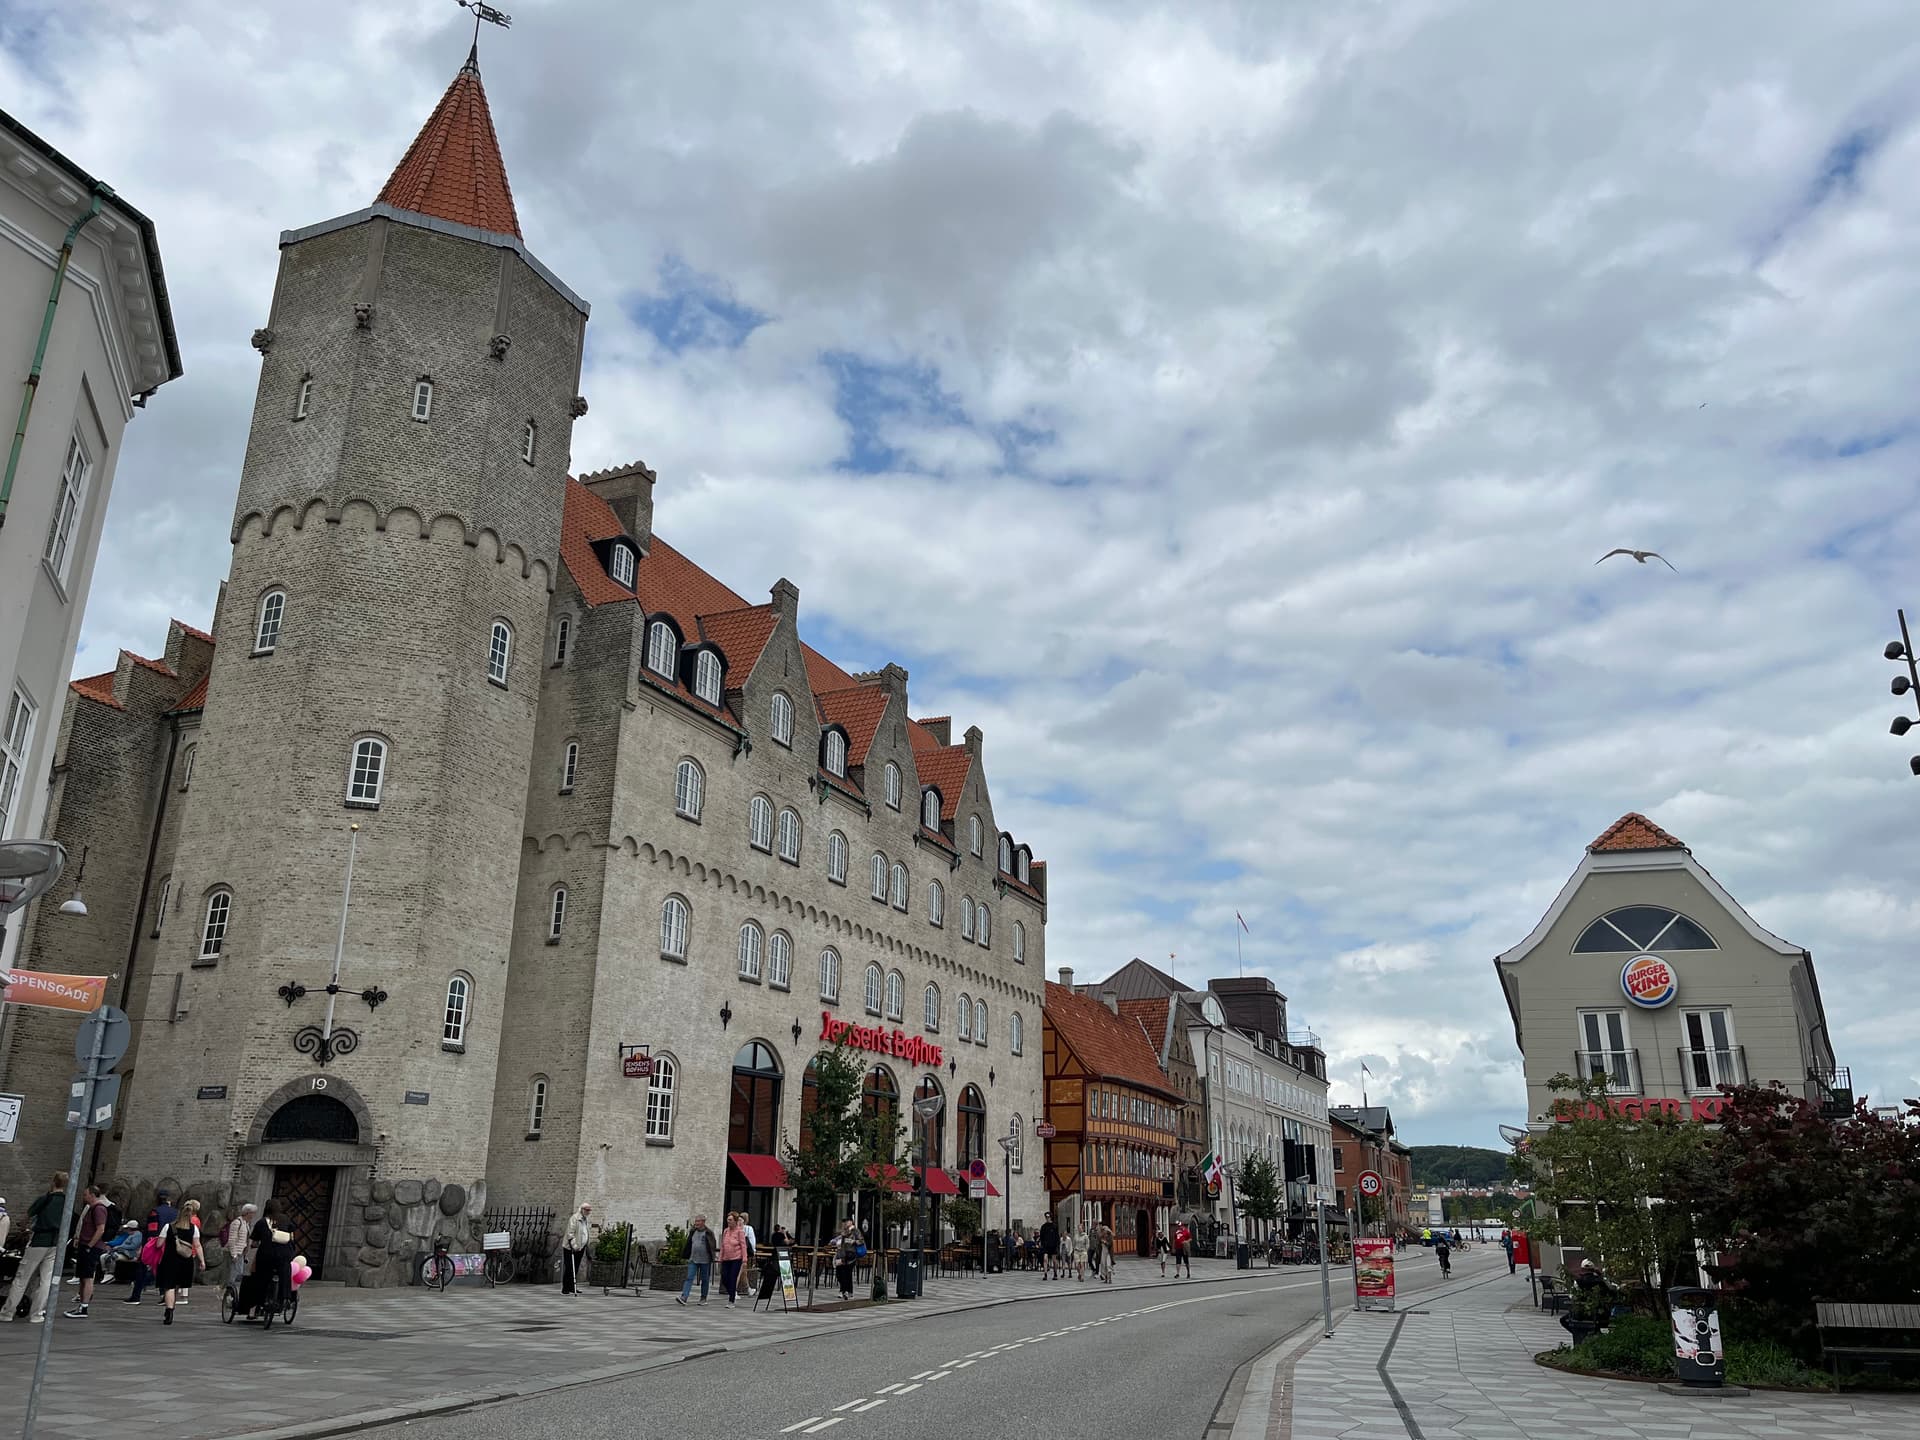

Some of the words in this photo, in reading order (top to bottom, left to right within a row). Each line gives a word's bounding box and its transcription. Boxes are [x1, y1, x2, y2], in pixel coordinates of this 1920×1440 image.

[1627, 964, 1666, 984] BURGER
[1631, 972, 1670, 997] KING
[820, 1011, 890, 1054] Jensen's
[893, 1030, 944, 1067] Bøfhus
[311, 1078, 327, 1090] 19
[1363, 1180, 1377, 1189] 30
